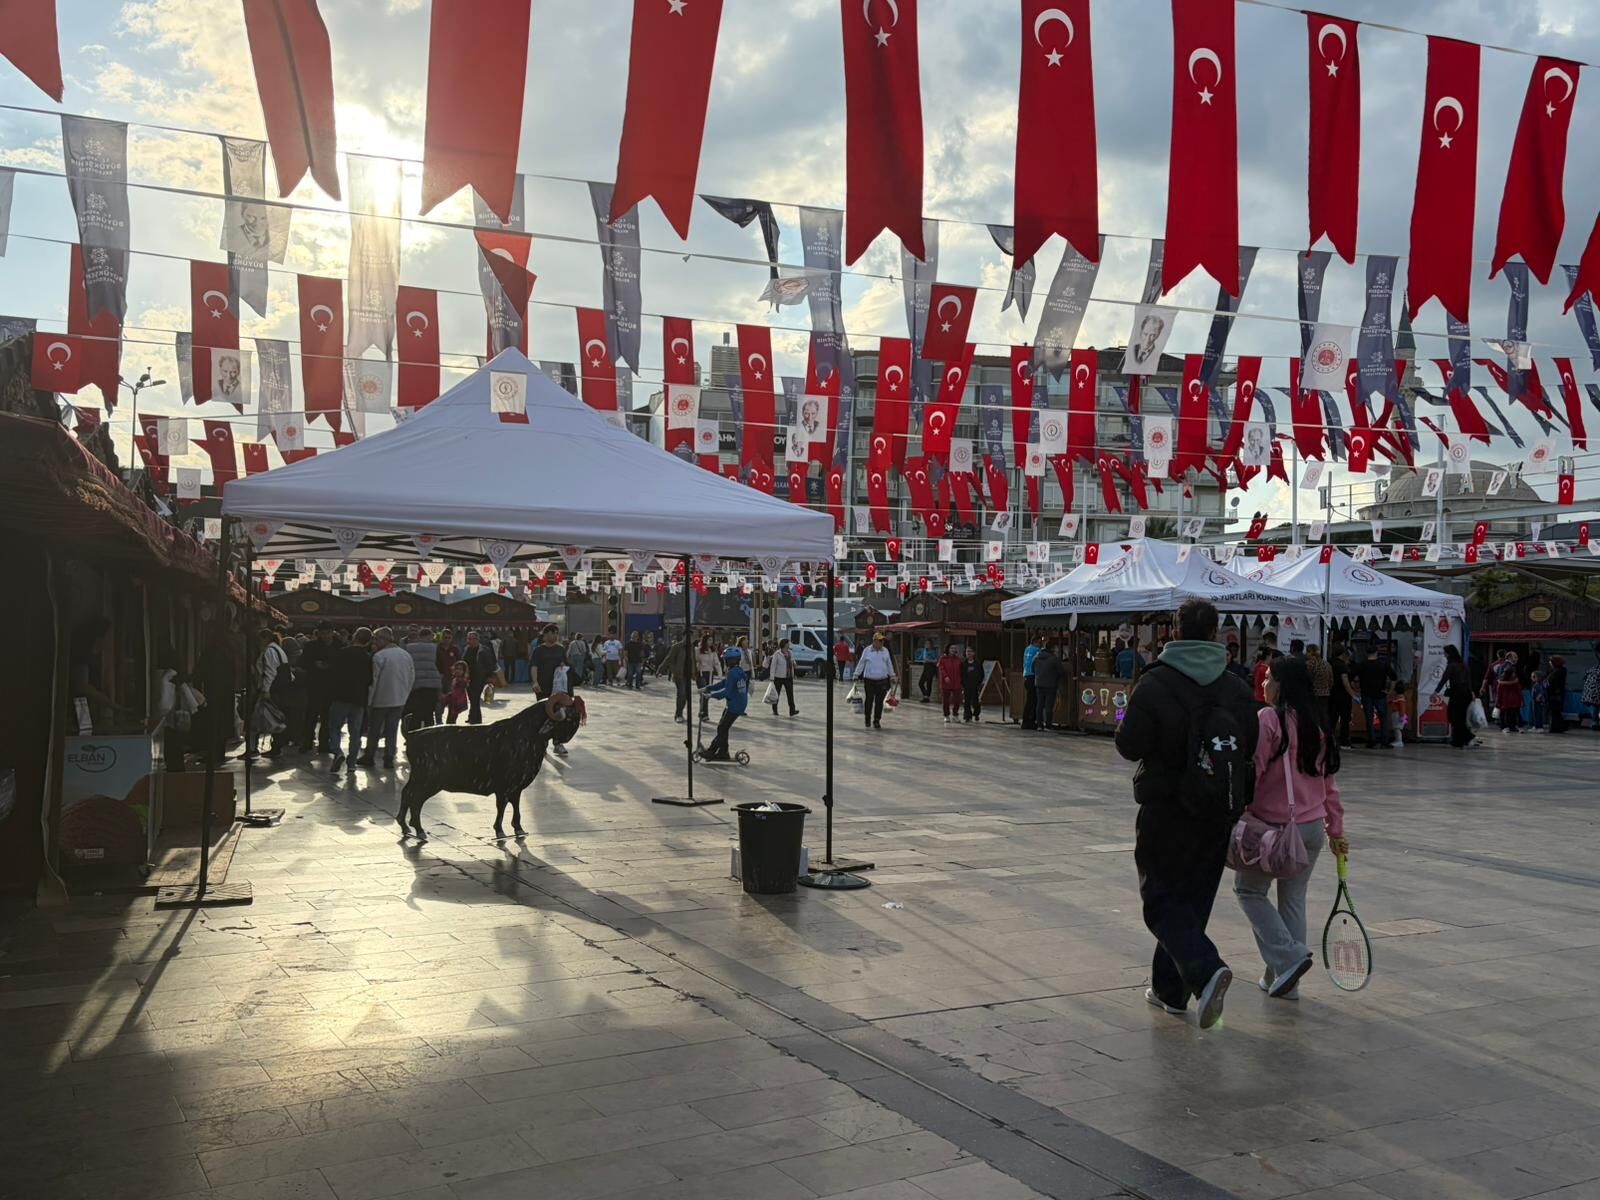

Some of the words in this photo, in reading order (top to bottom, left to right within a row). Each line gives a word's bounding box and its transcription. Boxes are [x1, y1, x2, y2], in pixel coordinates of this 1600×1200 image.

[1048, 596, 1079, 608] YURTLARI
[1079, 594, 1110, 606] KURUMU
[1401, 599, 1431, 608] KURUMU
